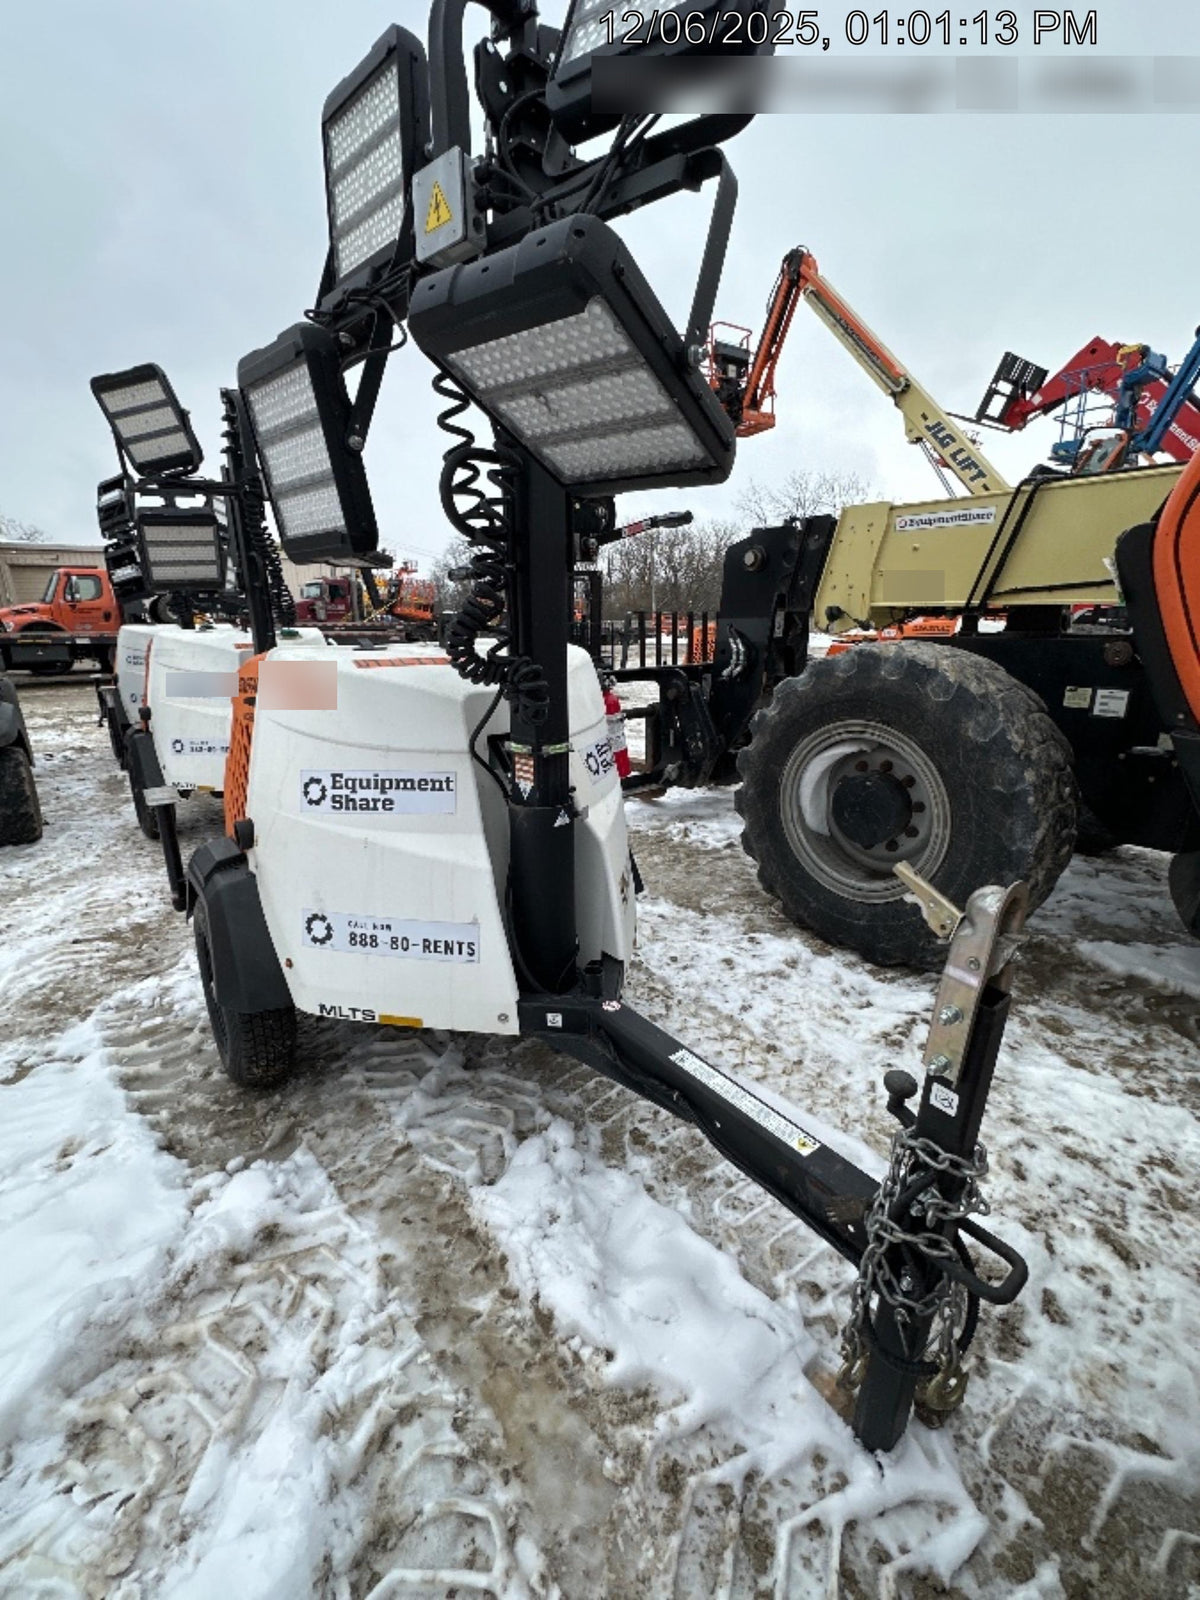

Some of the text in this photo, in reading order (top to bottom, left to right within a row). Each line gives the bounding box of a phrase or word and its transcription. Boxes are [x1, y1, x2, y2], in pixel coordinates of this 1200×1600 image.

[924, 420, 988, 483] JLG LIFT
[330, 772, 454, 795] Equipment
[330, 794, 395, 812] Share
[349, 931, 476, 957] 888-80-RENTS
[318, 1003, 376, 1021] MLTS
